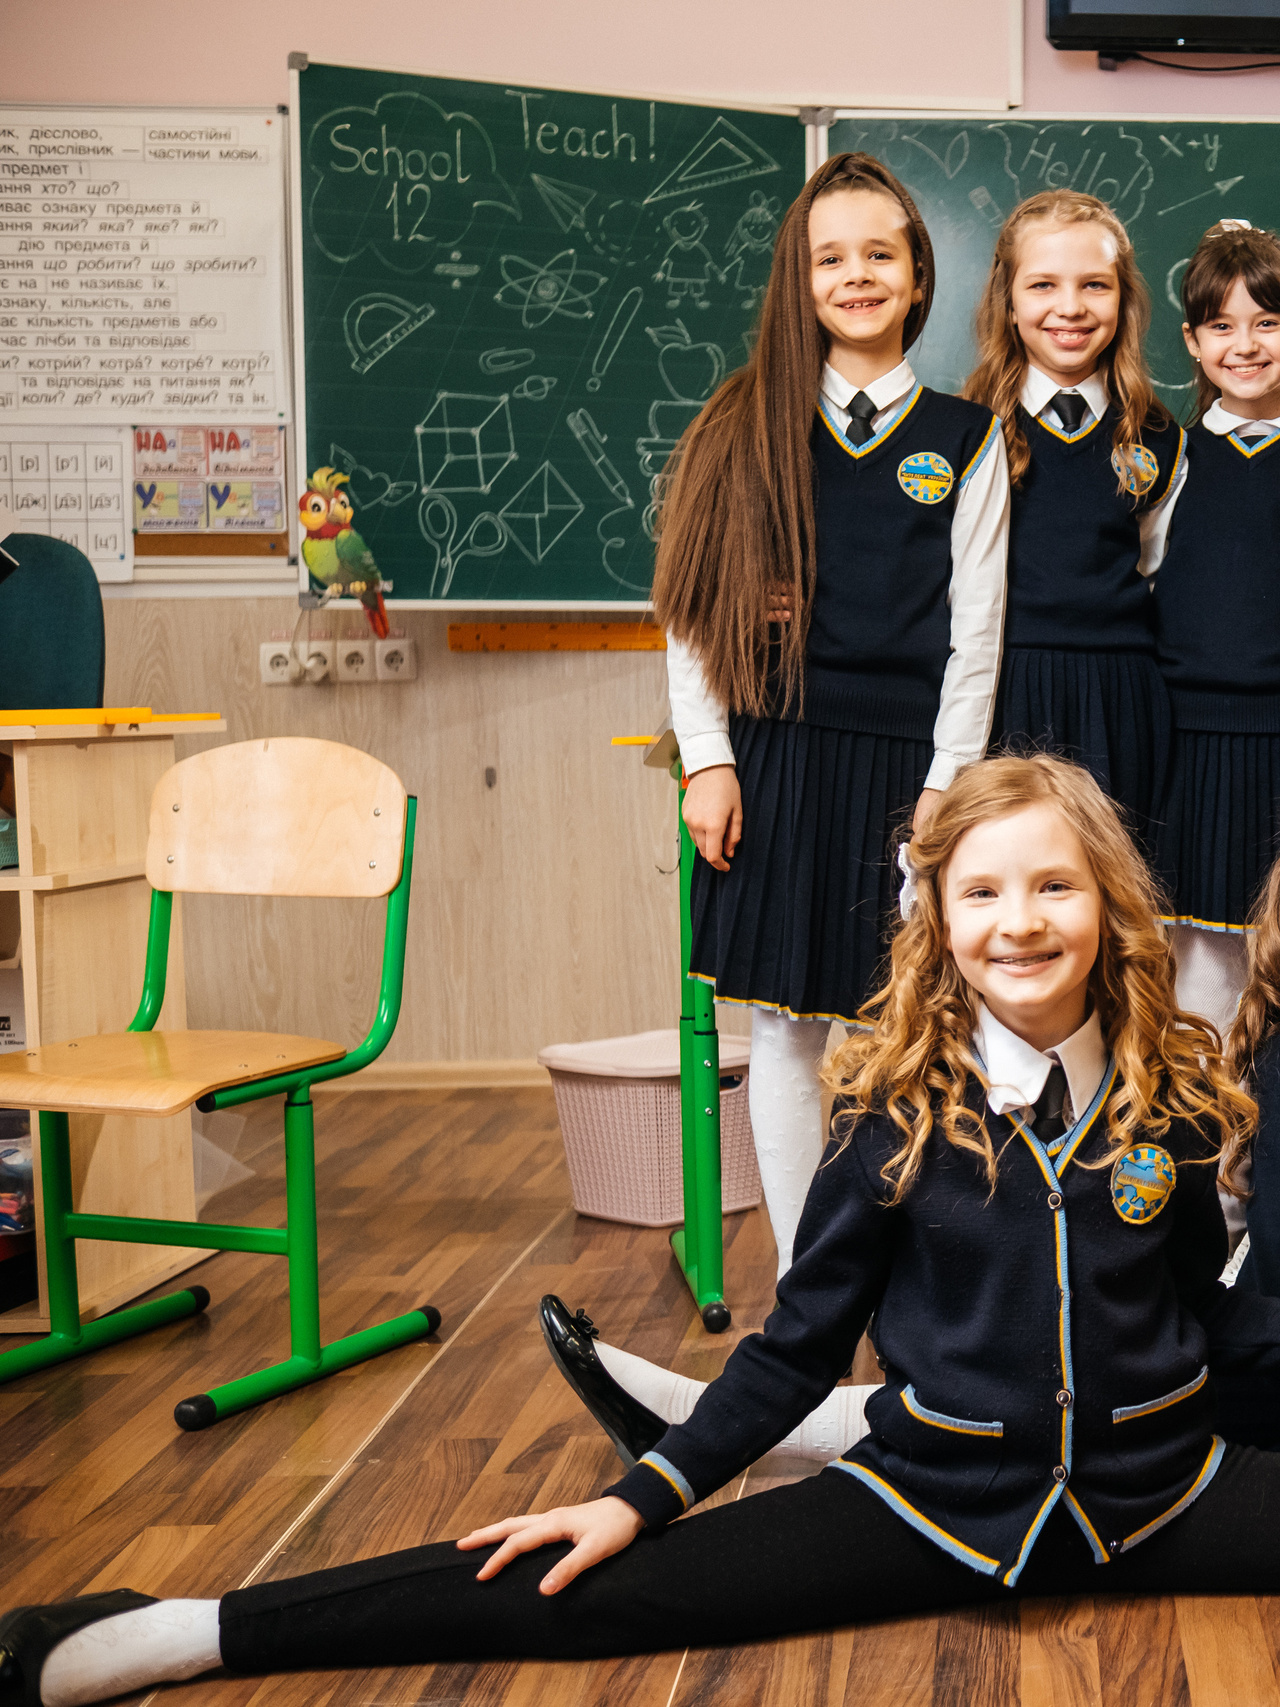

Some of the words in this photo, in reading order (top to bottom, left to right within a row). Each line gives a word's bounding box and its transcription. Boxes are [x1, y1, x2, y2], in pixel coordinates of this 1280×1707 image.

[28, 126, 103, 142] дієслово,
[148, 127, 232, 141] самостійні
[505, 89, 656, 163] Teach!
[28, 142, 114, 157] прислівник
[148, 148, 211, 161] частини
[219, 149, 263, 162] мови.
[330, 123, 471, 183] School
[1, 163, 69, 178] предмет
[41, 180, 77, 195] хто?
[86, 181, 120, 198] що?
[42, 202, 97, 218] ознаку
[106, 203, 182, 219] предмета
[191, 201, 201, 214] й
[386, 181, 436, 243] 12
[42, 218, 89, 233] який?
[98, 218, 135, 233] яка?
[144, 218, 180, 233] яке?
[189, 218, 219, 233] які?
[18, 237, 45, 252] дію
[54, 240, 131, 255] предмета
[140, 238, 150, 251] й
[43, 259, 68, 272] що
[77, 256, 141, 274] робити?
[151, 259, 176, 272] що
[183, 257, 258, 274] зробити?
[19, 278, 37, 290] на
[51, 278, 70, 290] не
[80, 278, 144, 291] називає
[0, 297, 52, 312] знаку,
[61, 295, 134, 310] кількість,
[143, 298, 173, 310] але
[27, 314, 94, 328] кількість
[102, 314, 181, 331] предметів
[189, 314, 219, 329] або
[36, 332, 77, 348] лічби
[84, 335, 102, 347] та
[109, 333, 192, 350] відповідає
[22, 376, 38, 388] та
[46, 374, 125, 390] відповідає
[133, 376, 152, 388] на
[160, 377, 221, 388] питання
[22, 390, 66, 405] коли?
[74, 390, 102, 406] де?
[110, 389, 155, 408] куди?
[163, 389, 219, 406] звідки?
[228, 392, 244, 405] та
